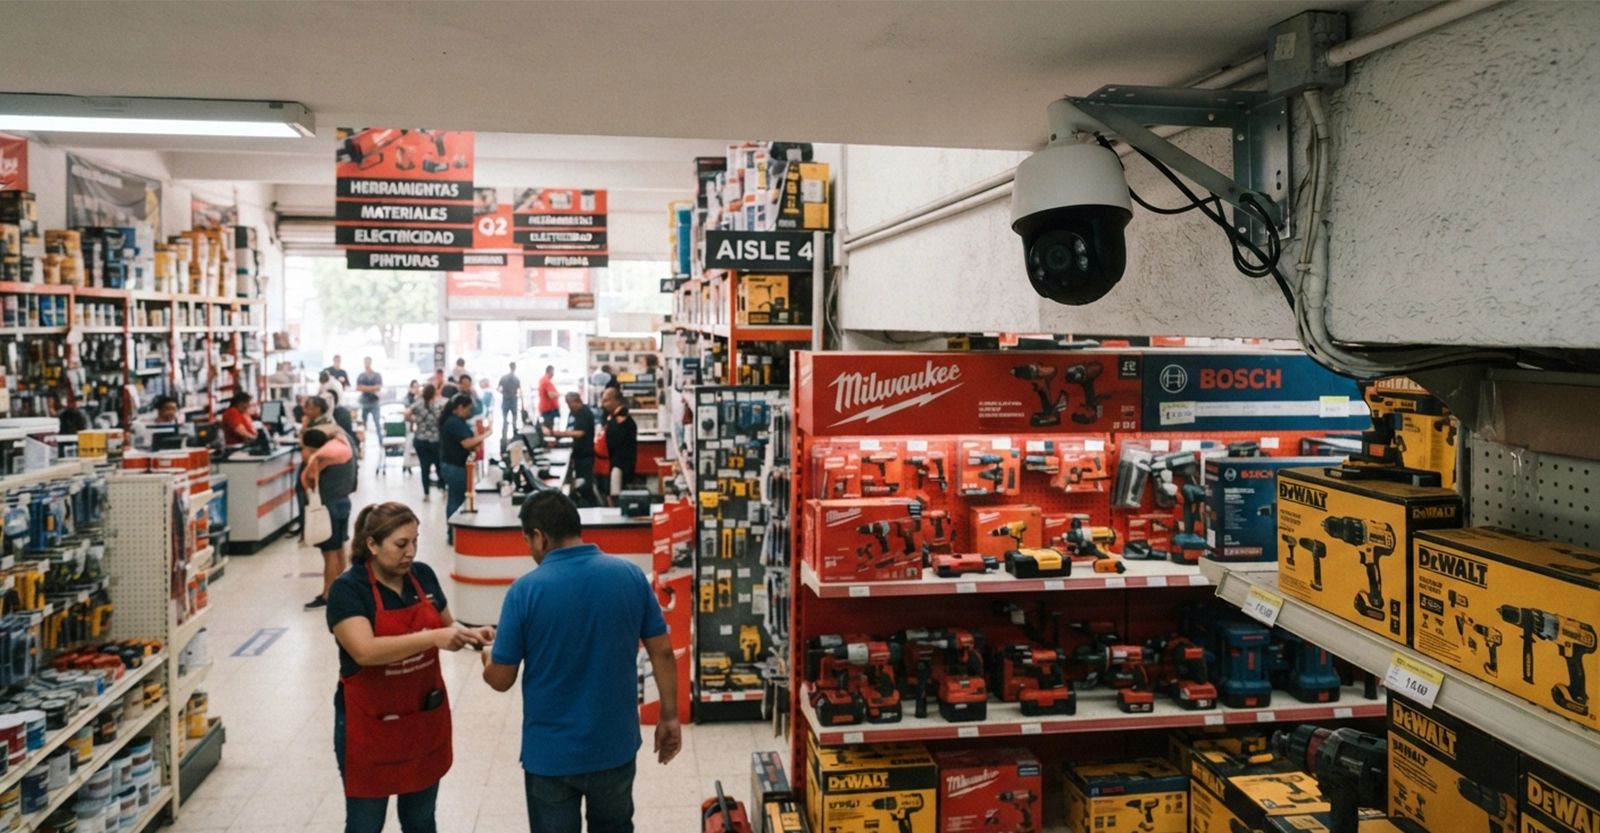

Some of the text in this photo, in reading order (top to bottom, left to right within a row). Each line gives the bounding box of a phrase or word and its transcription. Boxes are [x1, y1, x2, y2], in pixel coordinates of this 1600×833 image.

[361, 205, 447, 220] MATERIALES
[716, 239, 814, 261] AISLE 4
[370, 253, 440, 268] PINTURAS
[828, 361, 962, 413] Milwaukee
[1200, 369, 1282, 389] BOSCH
